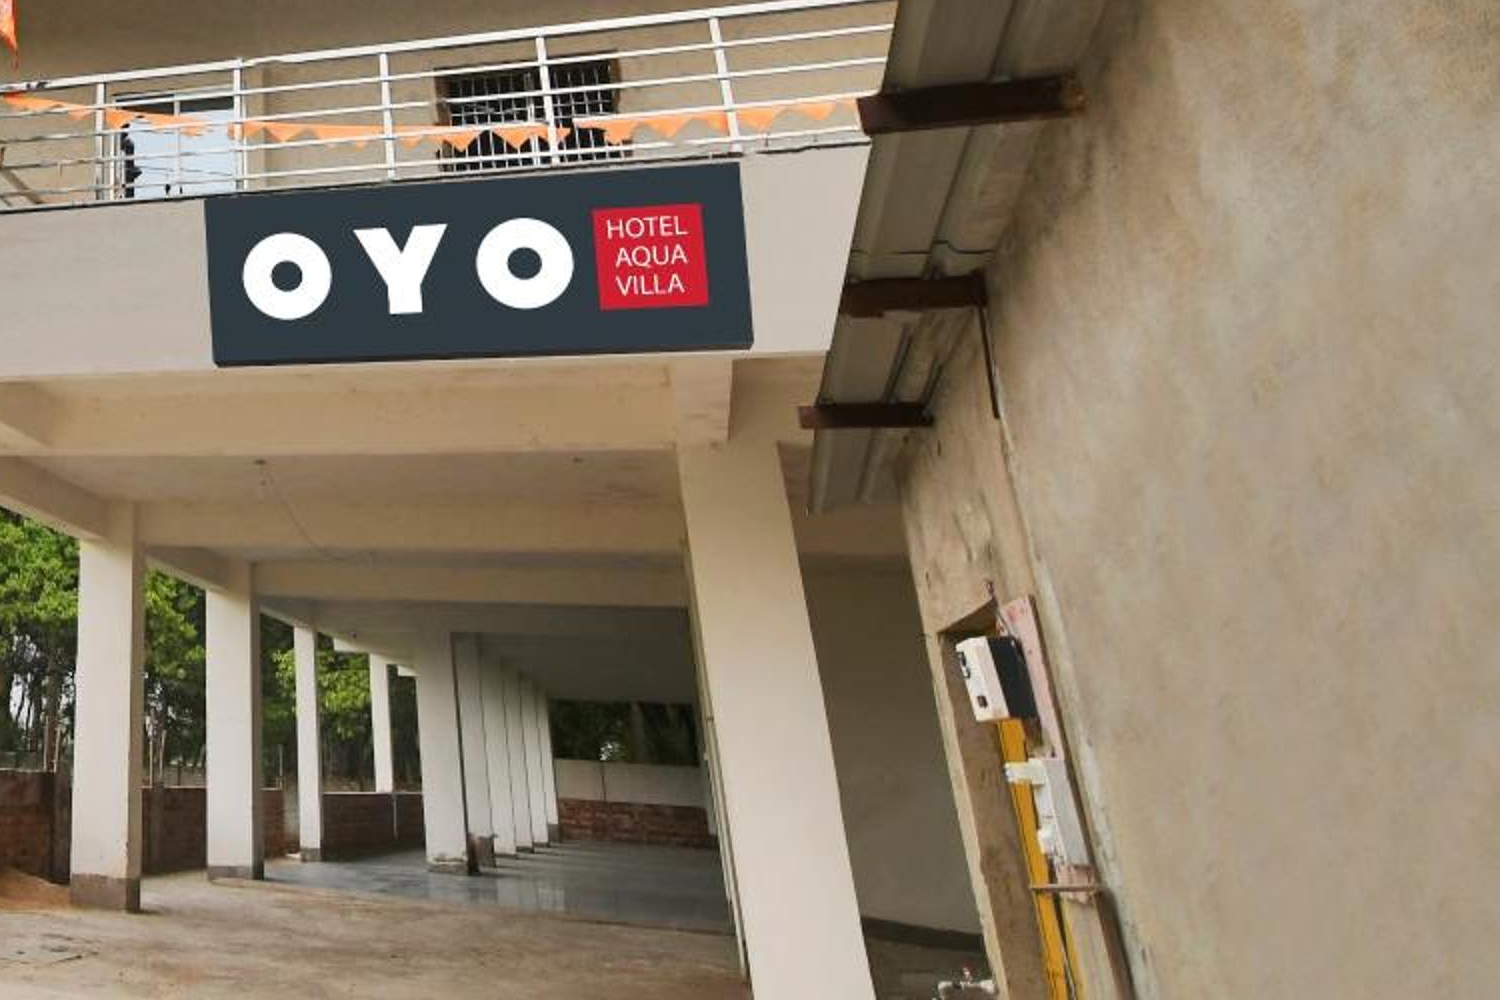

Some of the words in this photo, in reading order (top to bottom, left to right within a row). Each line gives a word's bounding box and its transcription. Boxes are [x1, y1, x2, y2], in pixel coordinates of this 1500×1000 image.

[607, 215, 688, 240] HOTEL
[242, 217, 574, 320] OYO
[615, 244, 688, 270] AQUA
[615, 273, 685, 296] VILLA
